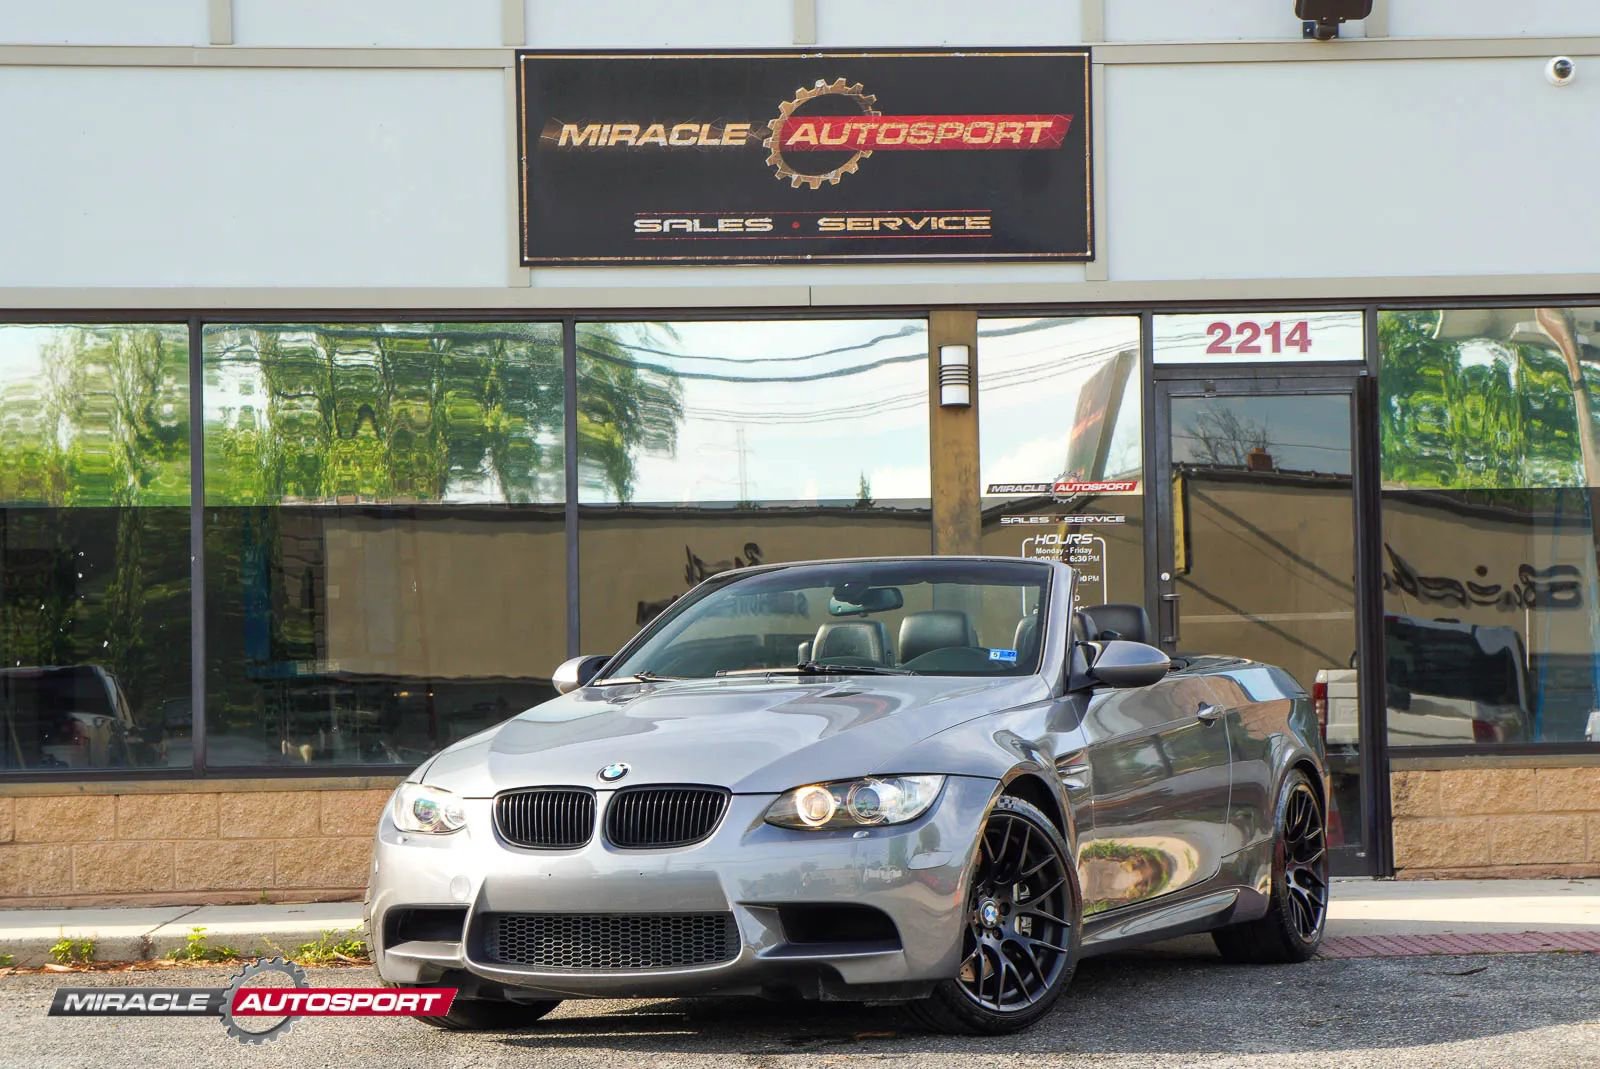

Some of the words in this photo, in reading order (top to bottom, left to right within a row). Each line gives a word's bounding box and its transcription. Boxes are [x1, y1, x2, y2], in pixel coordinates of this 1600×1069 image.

[558, 123, 752, 147] MIRACLE
[786, 120, 1054, 146] AUTOSPORT
[634, 217, 774, 233] SALES
[818, 215, 992, 232] SERVICE
[1206, 321, 1312, 354] 2214
[991, 485, 1046, 493] MIRACLE
[1056, 482, 1133, 492] AUTOSPORT
[1000, 516, 1049, 524] SALES
[1065, 515, 1126, 523] SERVICE
[1035, 534, 1093, 545] HOURS
[1035, 547, 1064, 556] Monday
[1069, 546, 1093, 555] Friday
